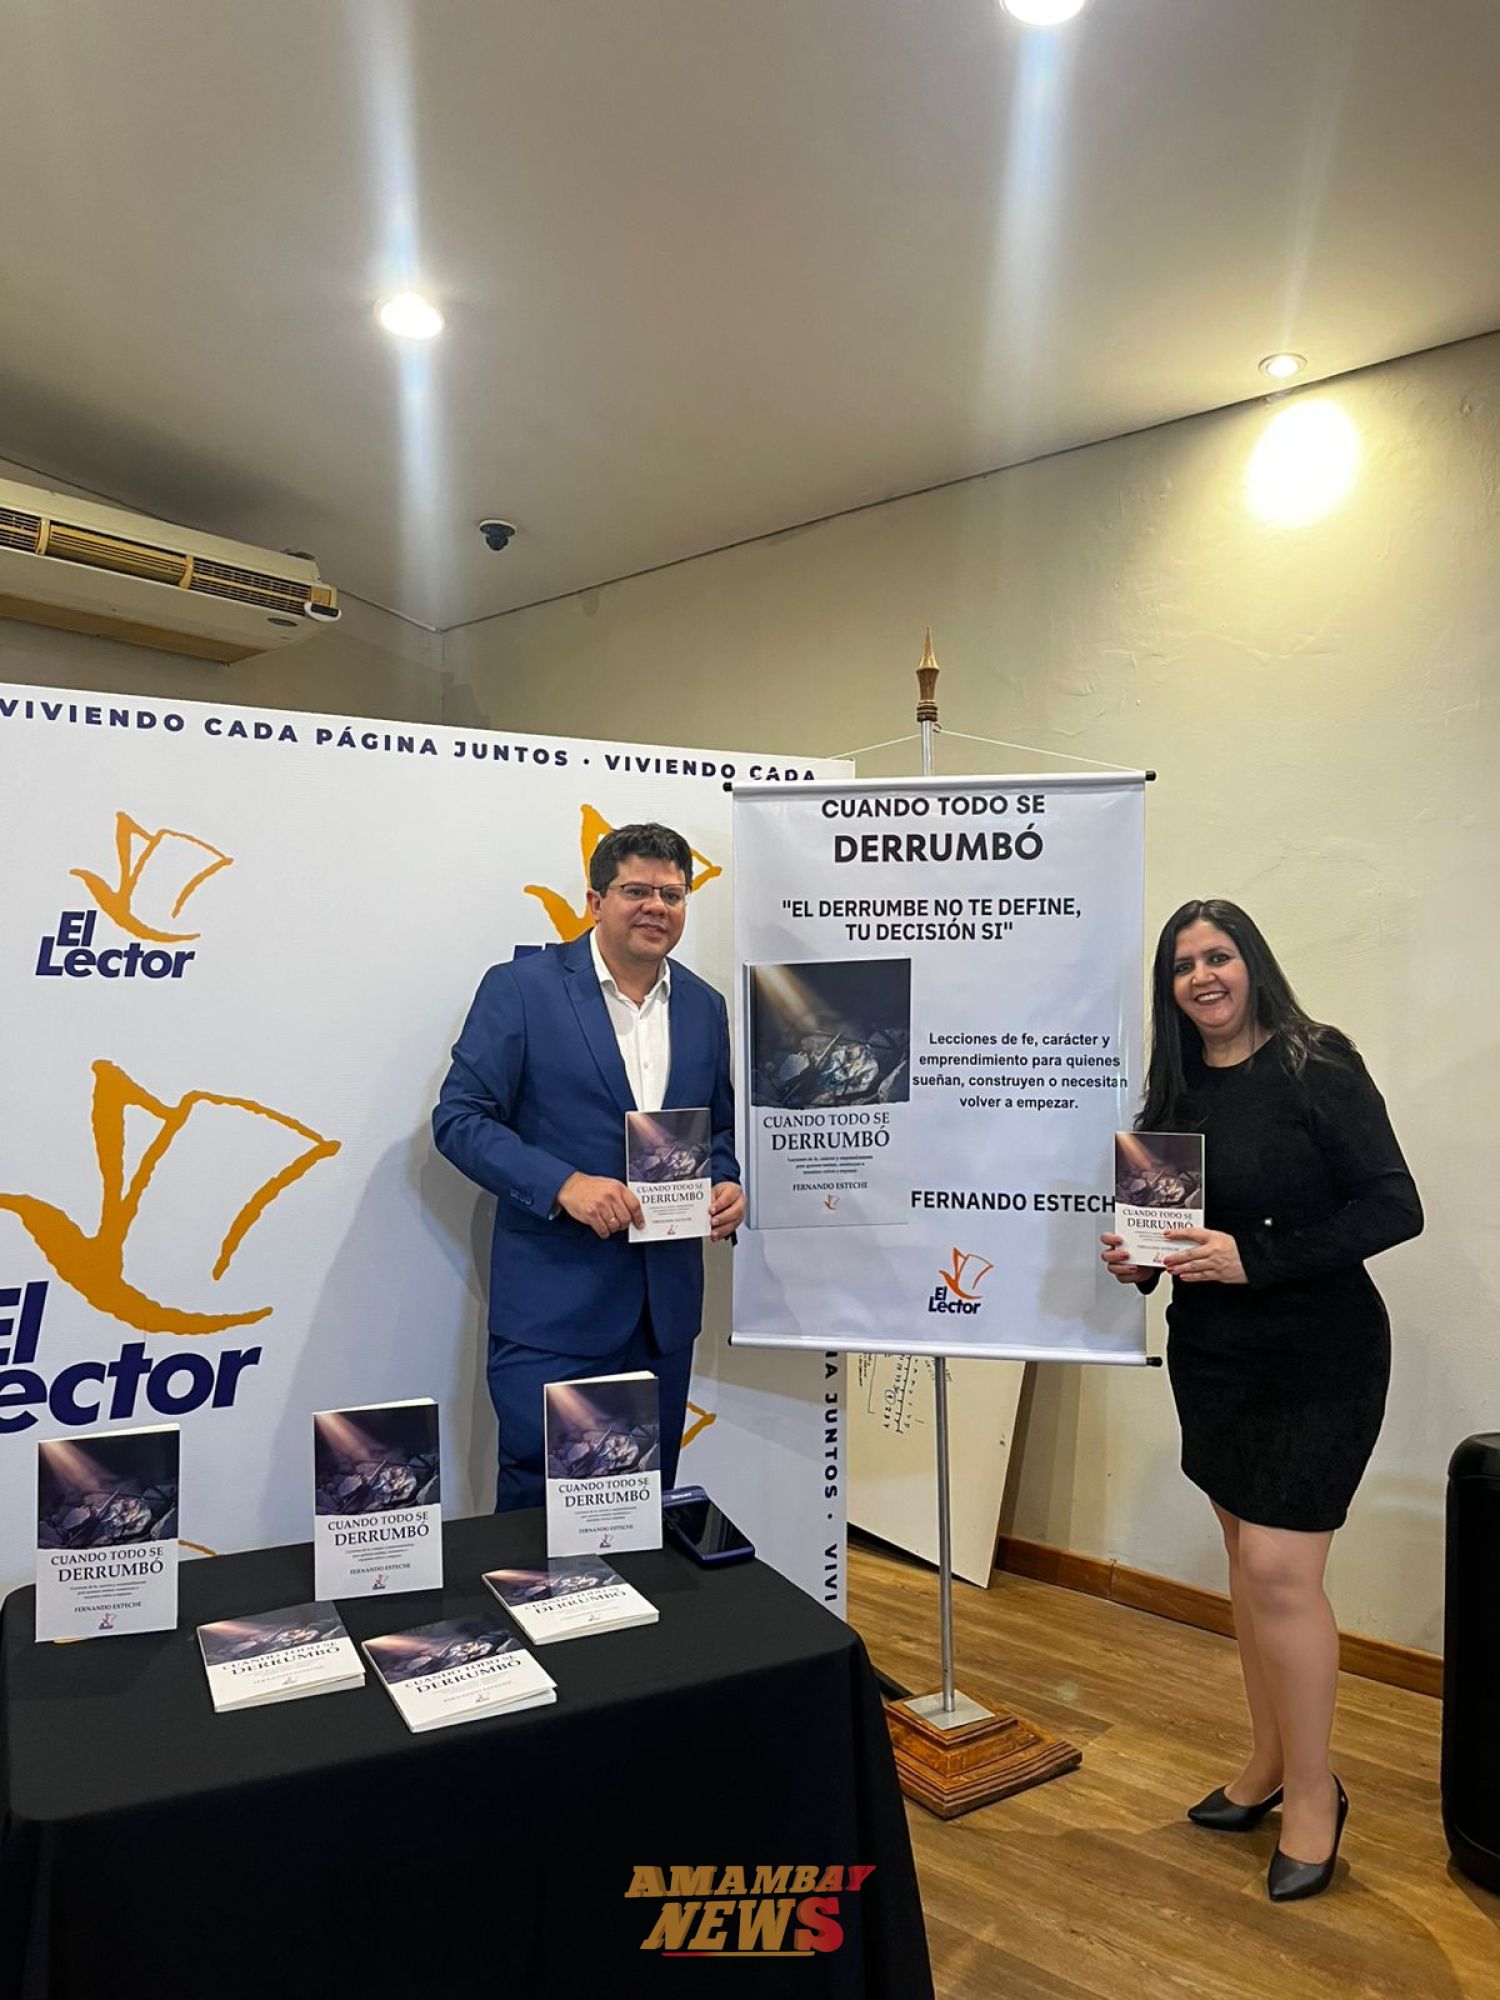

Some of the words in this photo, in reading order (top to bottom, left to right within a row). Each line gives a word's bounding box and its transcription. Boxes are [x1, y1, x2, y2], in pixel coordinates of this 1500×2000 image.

[0, 699, 186, 732] VIVIENDO
[204, 717, 298, 743] CADA
[315, 726, 438, 755] PÁGINA
[454, 741, 569, 767] JUNTOS
[605, 754, 736, 779] VIVIENDO
[749, 765, 815, 781] CADA
[821, 798, 930, 819] CUANDO
[937, 796, 1008, 816] TODO
[1016, 794, 1045, 814] SE
[834, 823, 1043, 863] DERRUMBÓ
[782, 900, 814, 918] "EL
[819, 899, 928, 917] DERRUMBE
[934, 899, 963, 916] NO
[968, 898, 992, 916] TE
[999, 898, 1081, 919] DEFINE,
[58, 910, 97, 947] El
[845, 923, 871, 941] TU
[876, 918, 976, 941] DECISIÓN
[981, 921, 1013, 940] SI"
[35, 936, 196, 978] Lector
[929, 1032, 998, 1045] Lecciones
[1001, 1032, 1018, 1045] de
[1021, 1032, 1038, 1047] fe,
[1042, 1033, 1098, 1046] carácter
[1101, 1036, 1110, 1048] y
[919, 1053, 1029, 1068] emprendimiento
[1031, 1055, 1062, 1069] para
[1066, 1054, 1121, 1069] quienes
[912, 1073, 965, 1088] sueñan,
[968, 1074, 1045, 1090] construyen
[1048, 1078, 1058, 1087] o
[1061, 1076, 1128, 1088] necesitan
[959, 1095, 1002, 1108] volver
[1004, 1098, 1013, 1108] a
[1016, 1099, 1079, 1111] empezar.
[763, 1114, 825, 1128] CUANDO
[828, 1112, 870, 1126] TODO
[873, 1112, 890, 1124] SE
[772, 1125, 890, 1151] DERRUMBÓ
[636, 1184, 671, 1193] CUANDO
[641, 1188, 704, 1204] DERRUMBÓ
[792, 1182, 835, 1191] FERNANDO
[836, 1181, 868, 1189] ESTECHE
[911, 1189, 1027, 1211] FERNANDO
[1034, 1193, 1116, 1213] ESTECH
[1122, 1208, 1157, 1218] CUANDO
[1159, 1211, 1182, 1219] TODO
[934, 1286, 948, 1301] El
[928, 1296, 981, 1315] Lector
[0, 1340, 262, 1434] ector
[824, 1393, 838, 1499] JUNTOS
[558, 1481, 604, 1493] CUANDO
[606, 1478, 636, 1489] TODO
[638, 1477, 649, 1486] SE
[565, 1486, 650, 1508] DERRUMBÓ
[328, 1517, 378, 1531] CUANDO
[380, 1513, 414, 1525] TODO
[416, 1511, 428, 1520] SE
[335, 1521, 429, 1546] DERRUMBÓ
[51, 1552, 107, 1566] CUANDO
[109, 1548, 146, 1561] TODO
[149, 1546, 164, 1556] SE
[58, 1557, 164, 1582] DERRUMBÓ
[824, 1543, 838, 1601] VIVI
